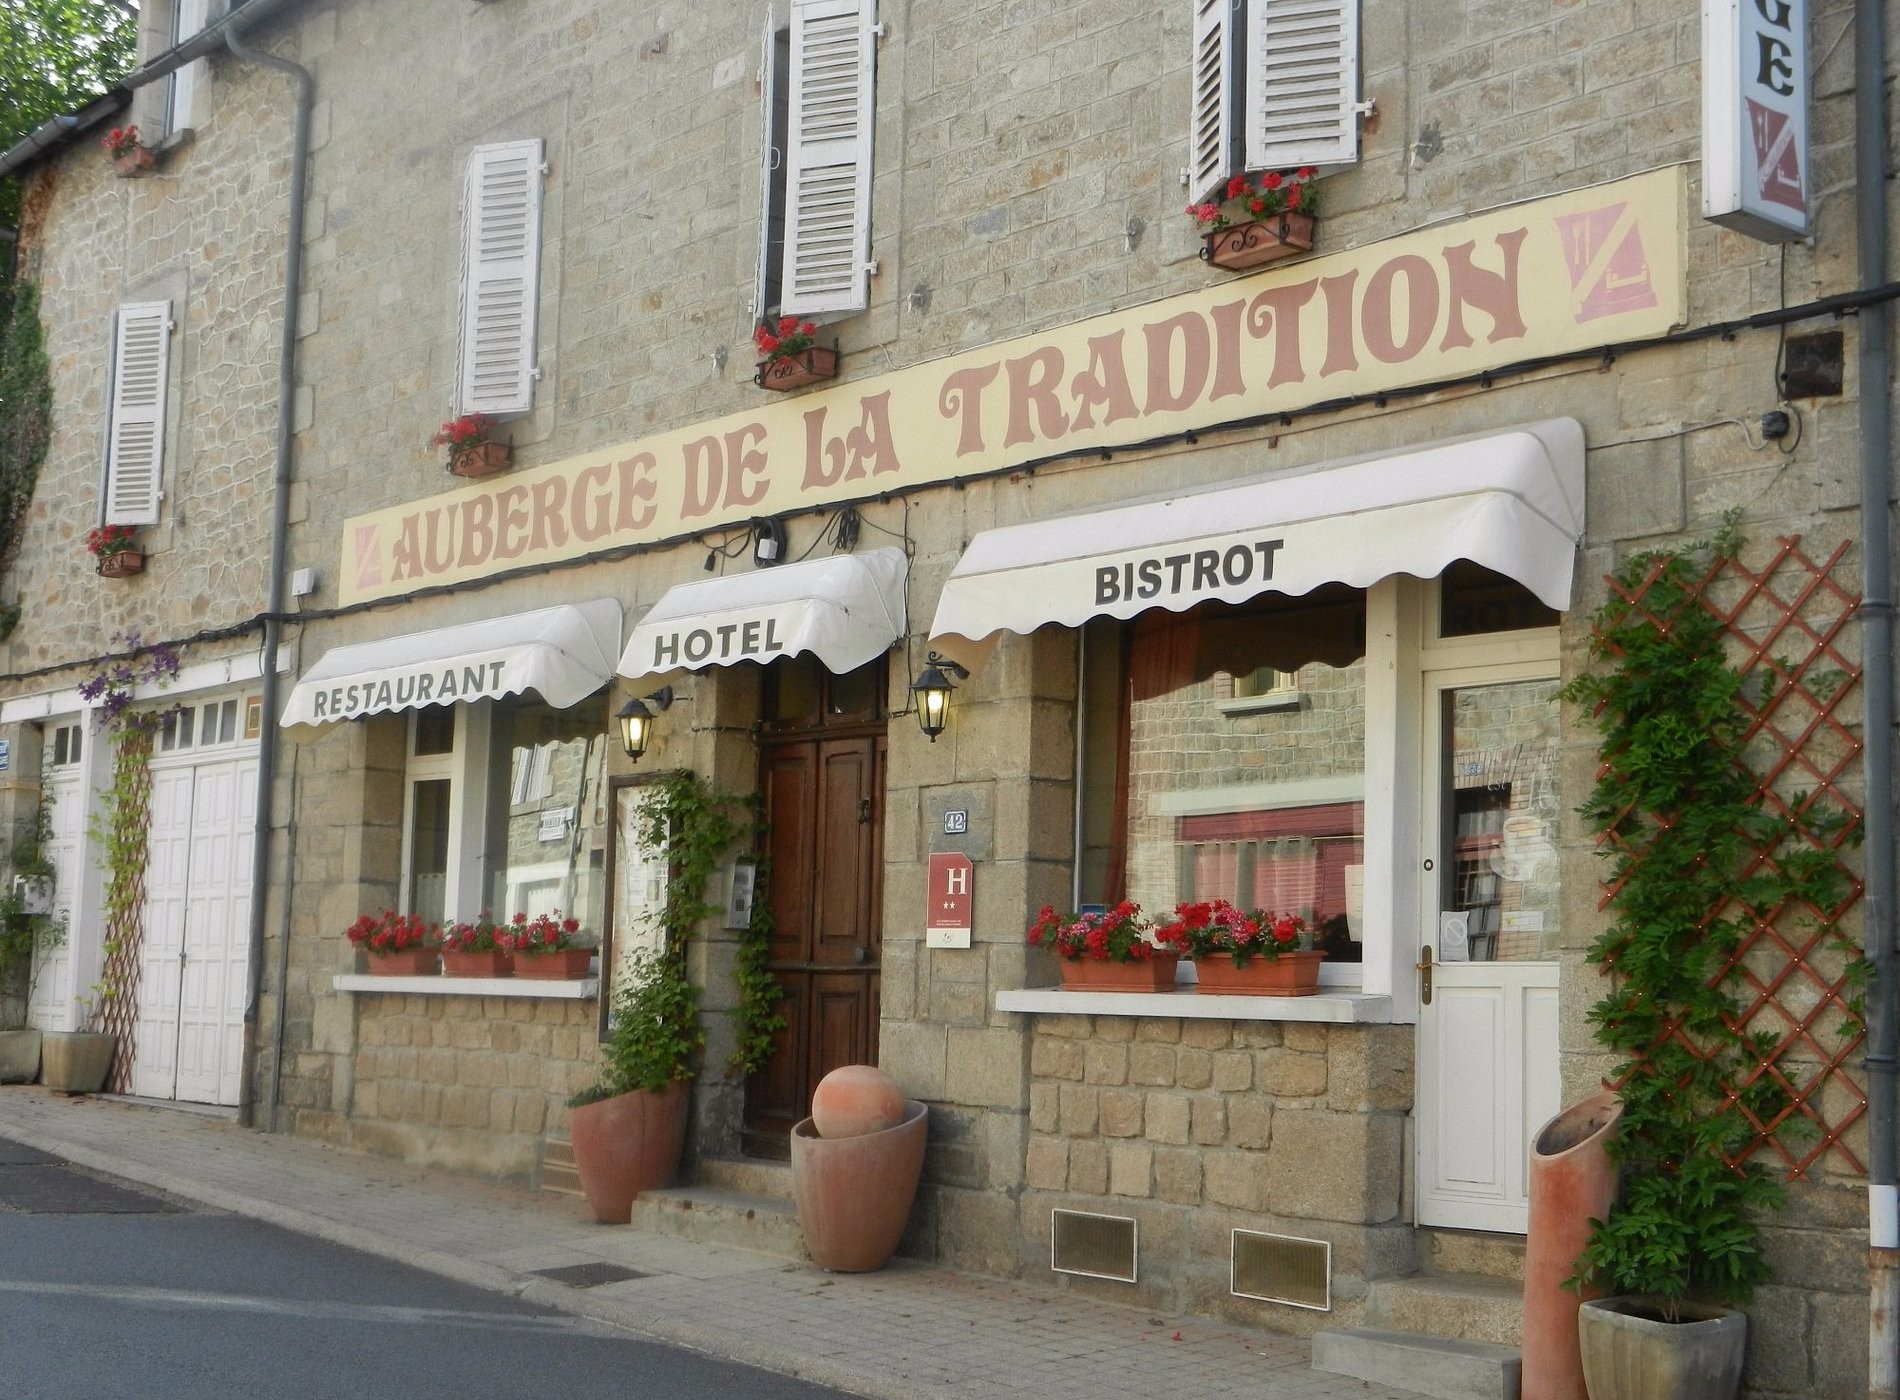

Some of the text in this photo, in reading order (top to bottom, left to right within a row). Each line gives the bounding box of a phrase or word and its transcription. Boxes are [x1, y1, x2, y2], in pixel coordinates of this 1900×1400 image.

[391, 226, 1528, 582] AUBERGE DE LA TRADITION
[1095, 539, 1284, 606] BISTROT
[654, 618, 784, 667] HOTEL
[313, 660, 506, 717] RESTAURANT
[947, 814, 964, 830] 42
[946, 868, 968, 895] H
